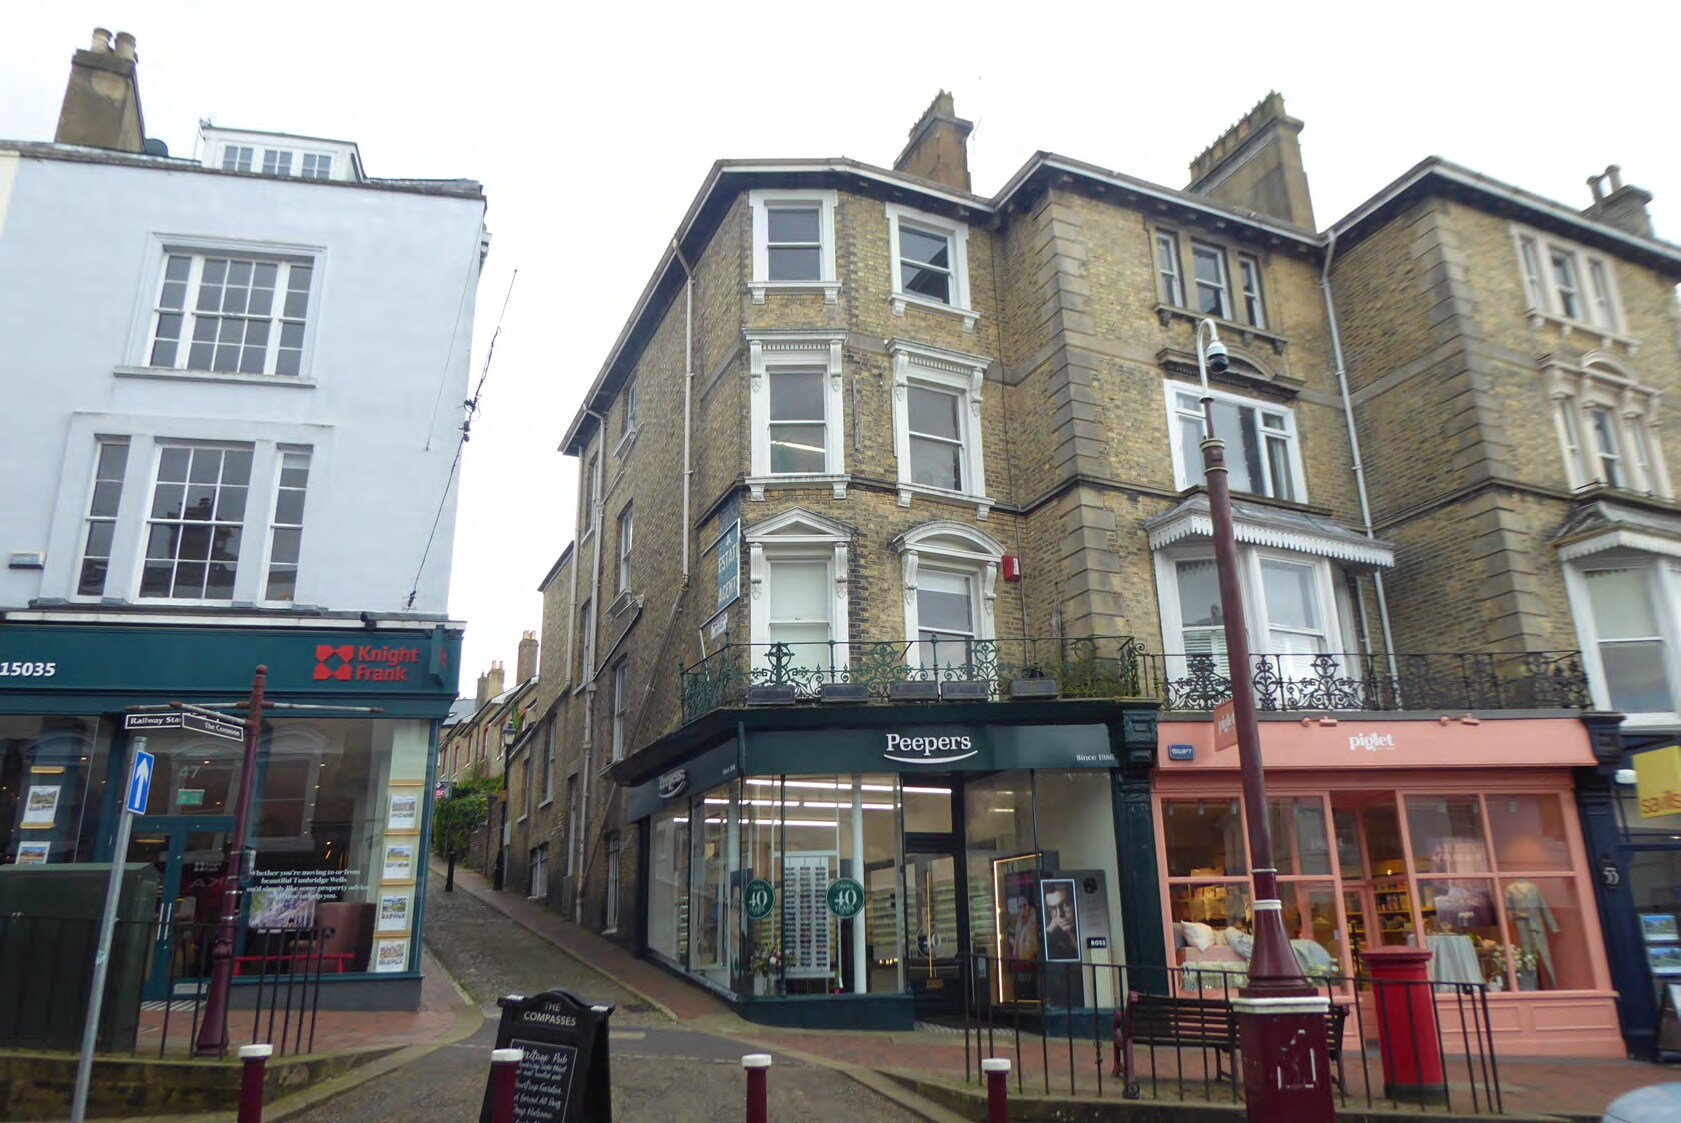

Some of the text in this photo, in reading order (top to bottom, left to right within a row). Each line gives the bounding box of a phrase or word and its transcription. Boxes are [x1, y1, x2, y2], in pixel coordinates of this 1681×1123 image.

[358, 645, 419, 666] Knight
[0, 662, 56, 676] 15035
[356, 665, 407, 682] Frank
[130, 716, 181, 725] Railway Sta
[204, 721, 240, 737] The Common
[886, 733, 972, 756] Peepers
[1349, 732, 1396, 751] piglet
[280, 869, 301, 877] you're
[318, 885, 347, 893] property
[749, 891, 768, 906] 40
[834, 890, 857, 905] 40
[544, 1002, 561, 1011] THE
[523, 1010, 576, 1027] COMPASSES
[552, 1052, 568, 1064] Pub
